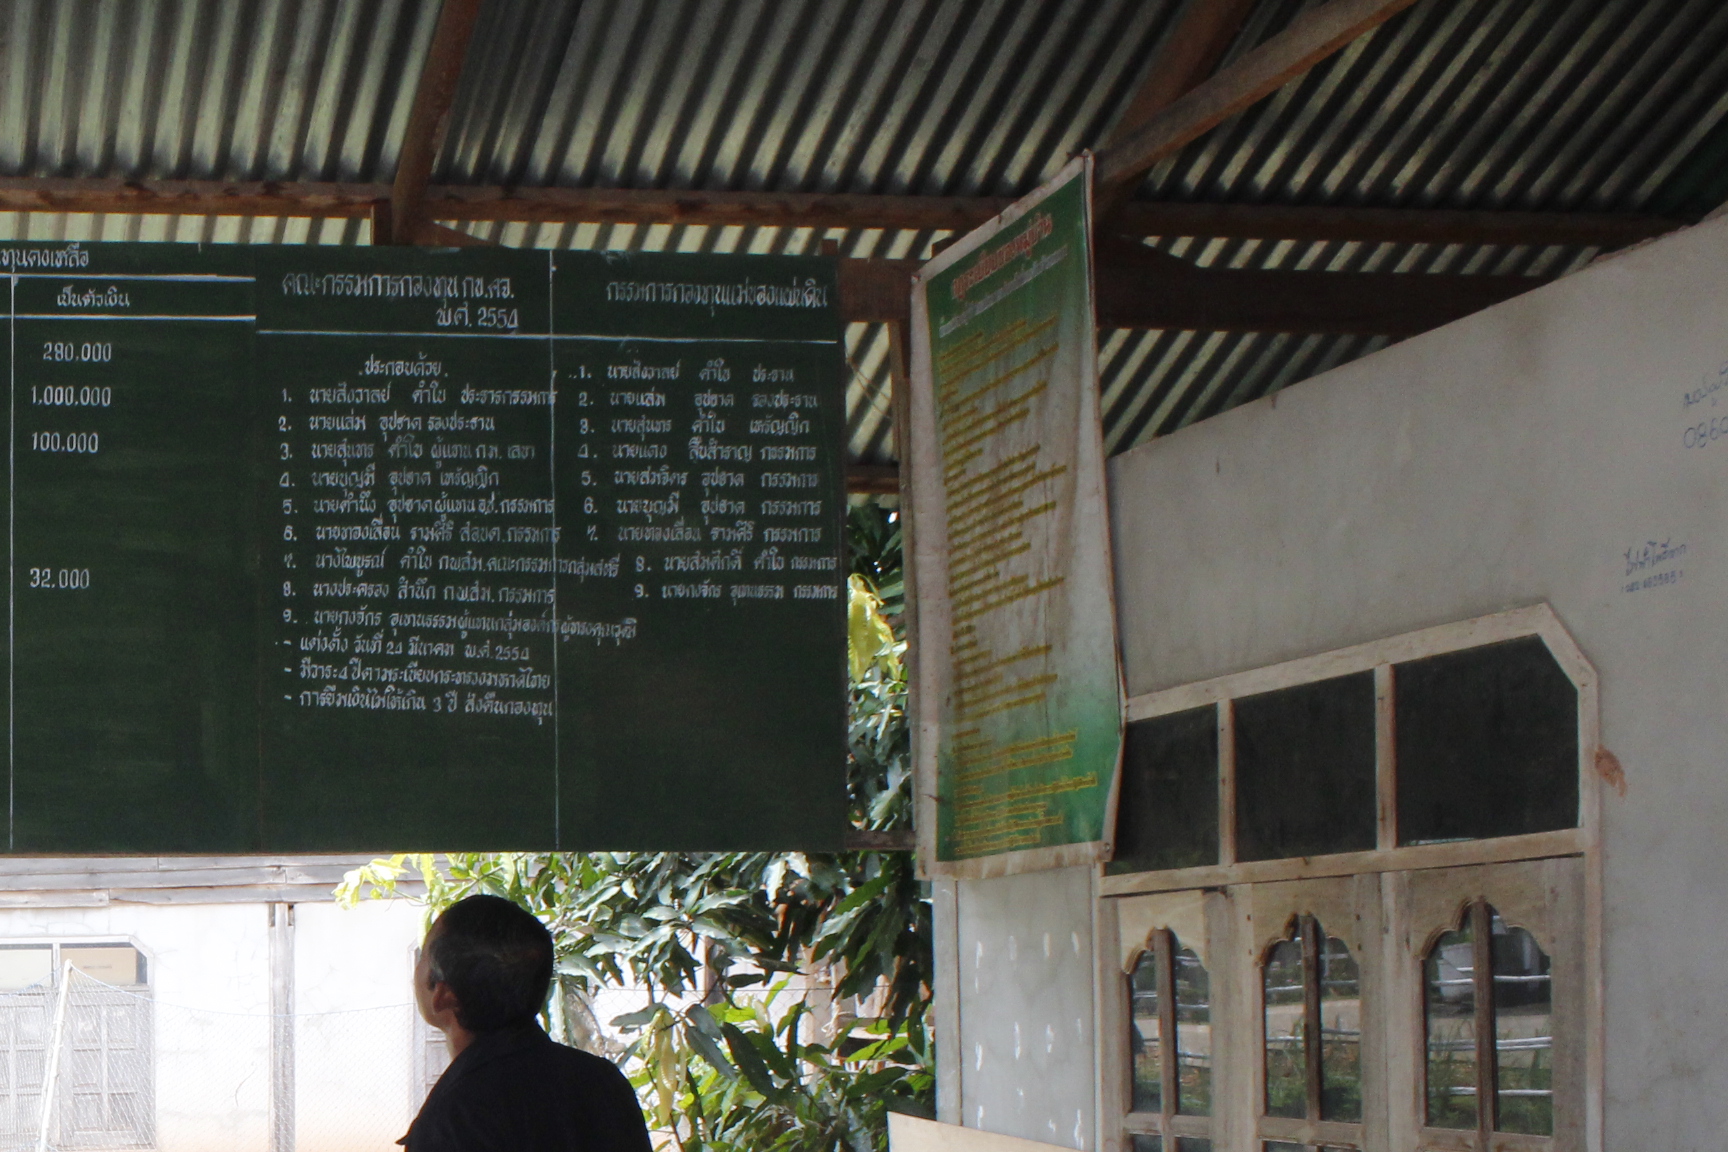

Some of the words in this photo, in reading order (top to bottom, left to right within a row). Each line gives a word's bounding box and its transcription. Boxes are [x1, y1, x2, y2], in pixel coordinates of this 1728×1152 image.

[57, 285, 130, 307] เป็นตัวเงิน
